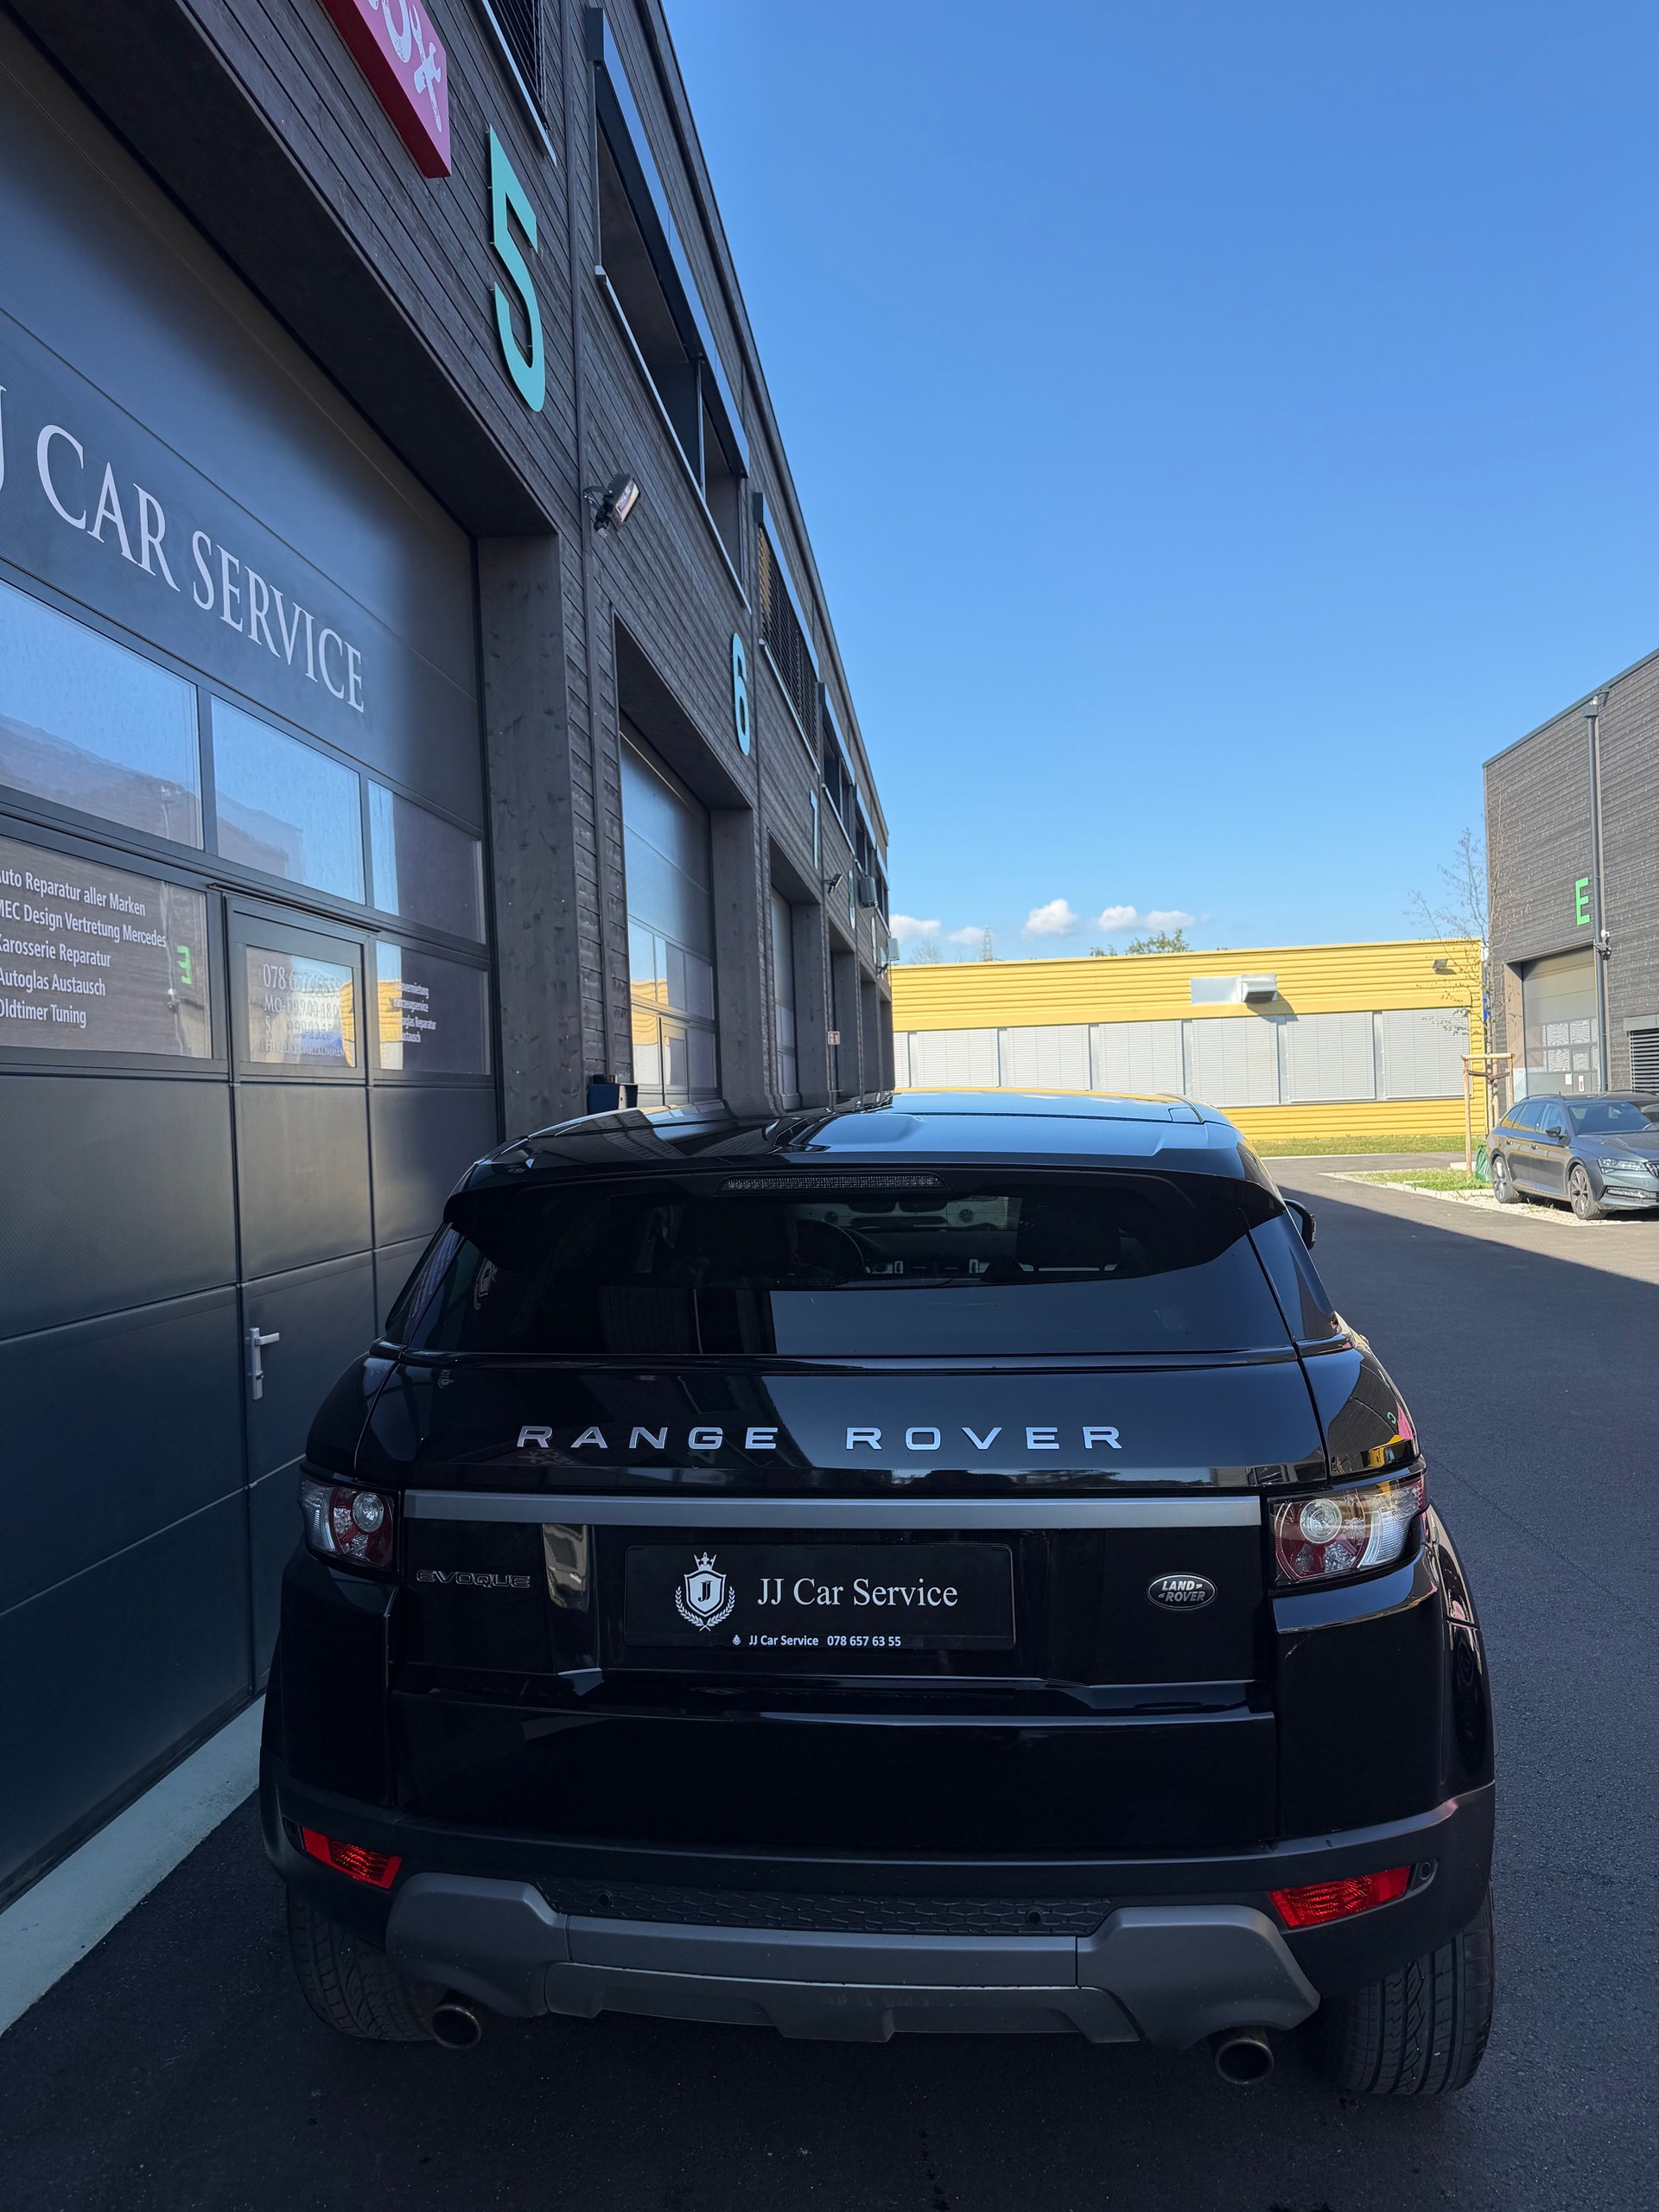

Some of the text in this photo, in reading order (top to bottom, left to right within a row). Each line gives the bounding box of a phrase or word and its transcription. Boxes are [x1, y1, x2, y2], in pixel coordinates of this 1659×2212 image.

[489, 123, 545, 412] 5
[37, 424, 180, 592] CAR
[192, 531, 364, 713] SERVICE
[732, 632, 751, 756] 6
[0, 868, 146, 917] uto Reparatur aller Marken
[1575, 877, 1590, 926] E
[24, 903, 63, 931] Design
[65, 912, 120, 943] Vertretung
[123, 924, 167, 948] Mercedes
[0, 933, 111, 968] arosserie Reparatur
[52, 973, 105, 996] Austausch
[263, 963, 287, 990] 078
[50, 1004, 86, 1029] Tuning
[517, 1426, 1122, 1451] RANGE ROVER
[416, 1569, 531, 1588] EVOQUE
[758, 1578, 958, 1606] JJ Car Service
[1161, 1580, 1195, 1591] LAND
[1165, 1591, 1205, 1602] ROVER
[748, 1634, 902, 1647] JJ Car Service 078 657 63 55
